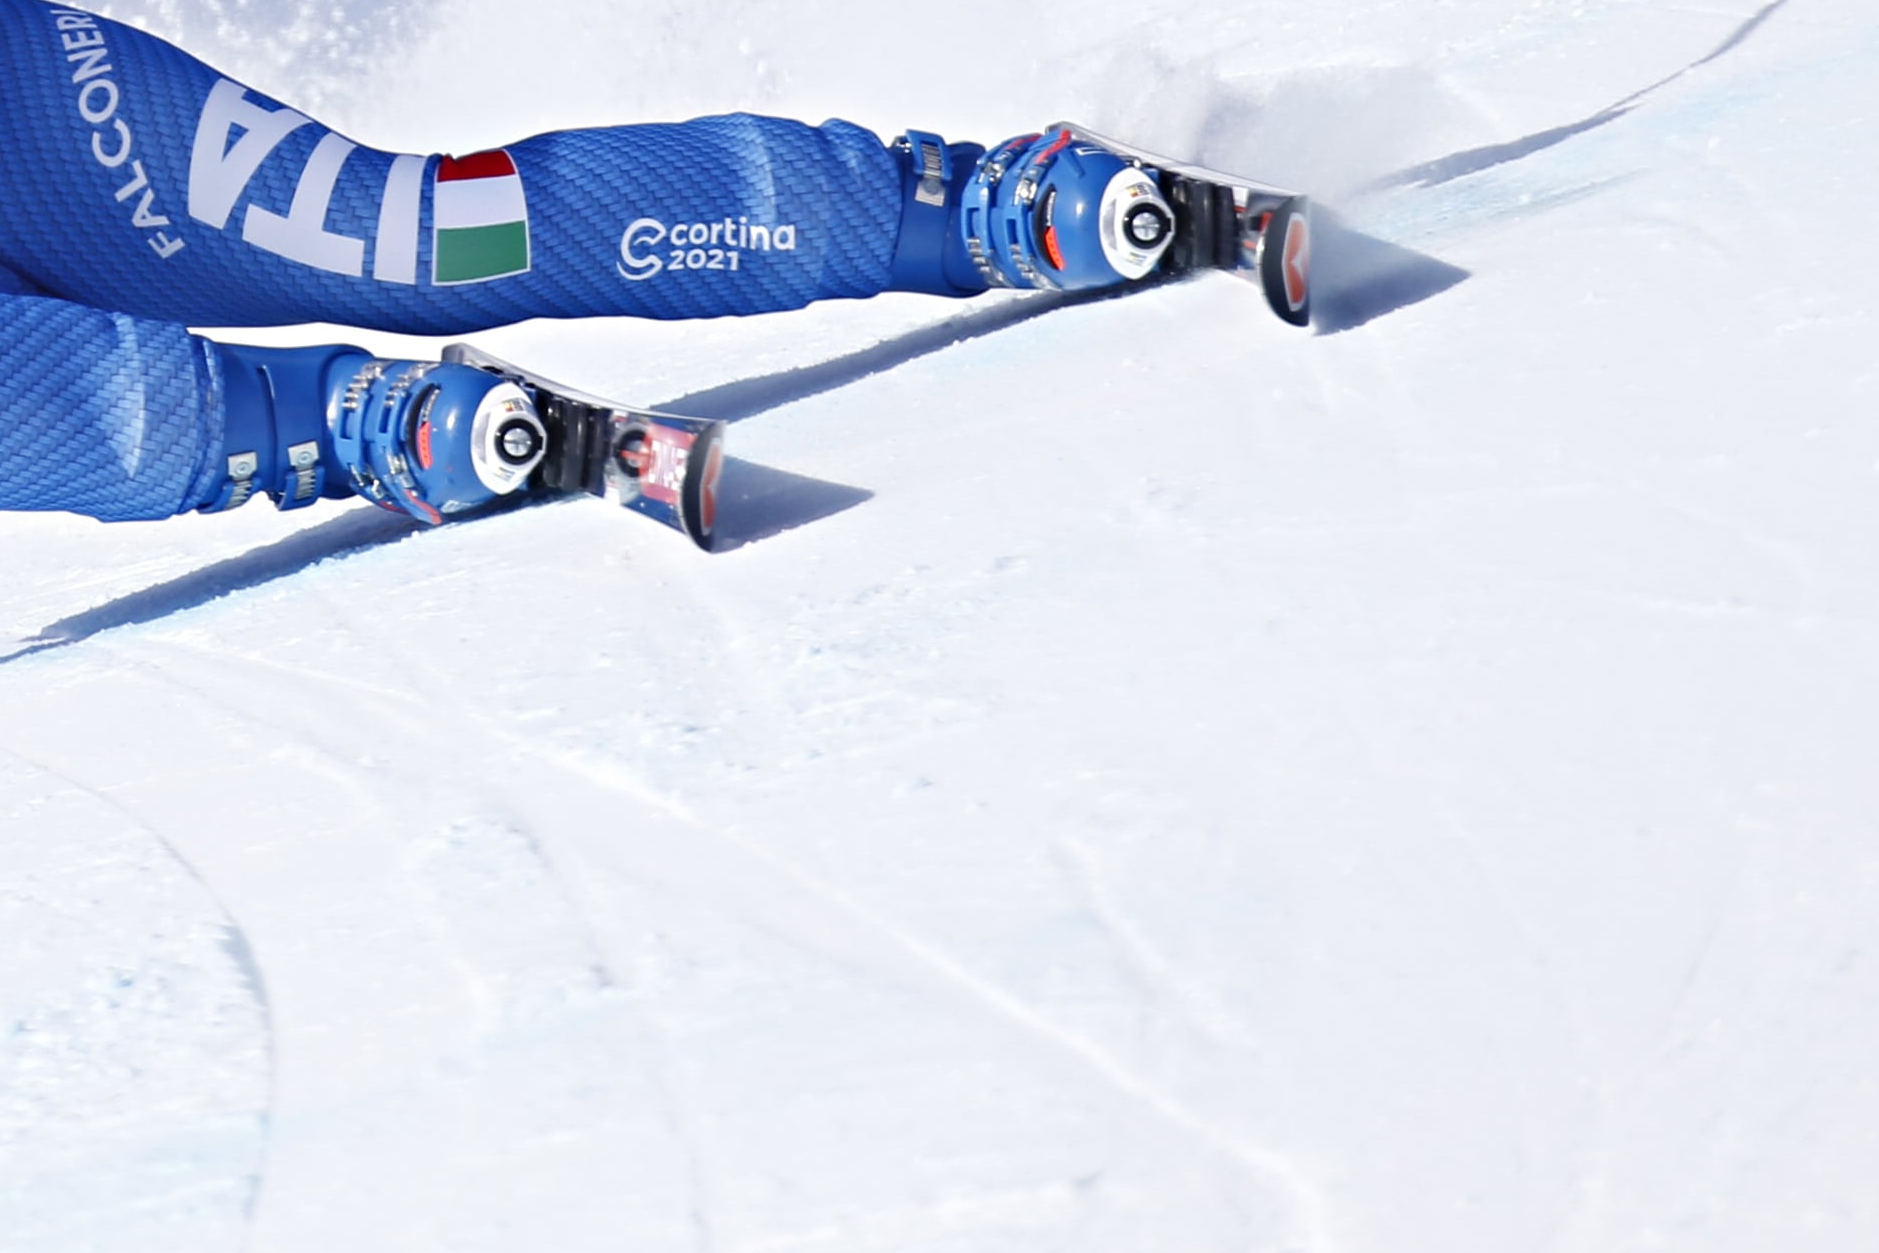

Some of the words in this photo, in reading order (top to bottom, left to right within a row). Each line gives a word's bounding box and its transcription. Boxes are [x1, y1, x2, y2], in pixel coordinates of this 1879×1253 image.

[49, 9, 186, 259] FALCONERI
[188, 77, 428, 286] ITA
[666, 248, 739, 271] 2021
[669, 216, 796, 252] cortina
